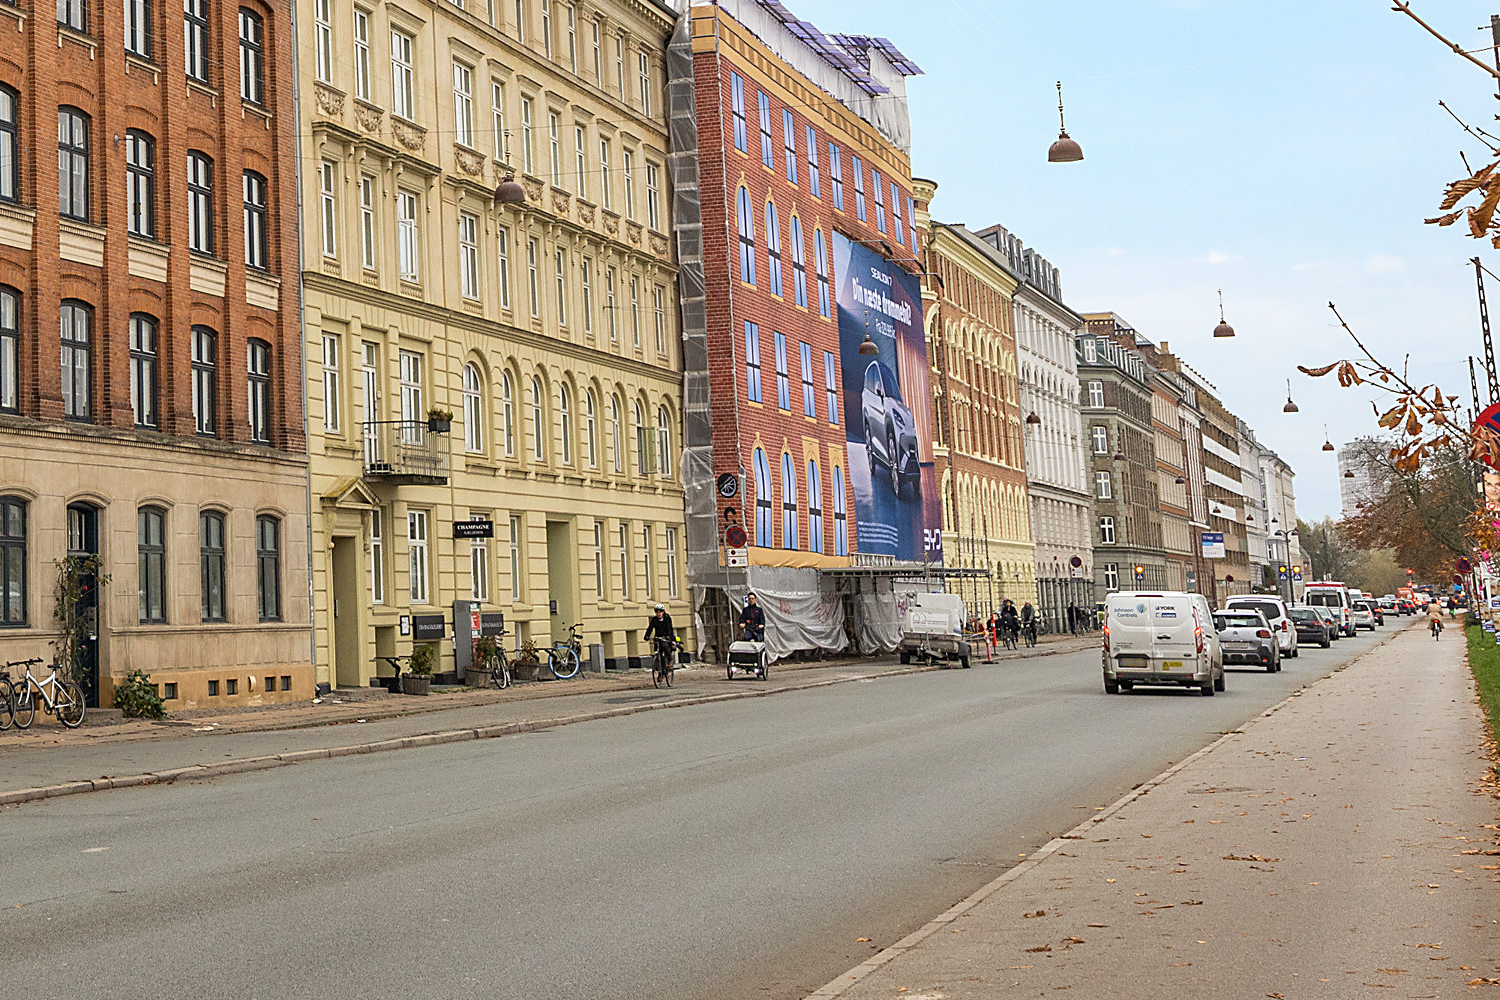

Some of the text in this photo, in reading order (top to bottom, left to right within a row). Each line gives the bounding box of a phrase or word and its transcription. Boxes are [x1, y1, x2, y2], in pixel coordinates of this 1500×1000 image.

[852, 277, 863, 303] Din
[864, 288, 882, 312] næste
[923, 528, 941, 551] BYD
